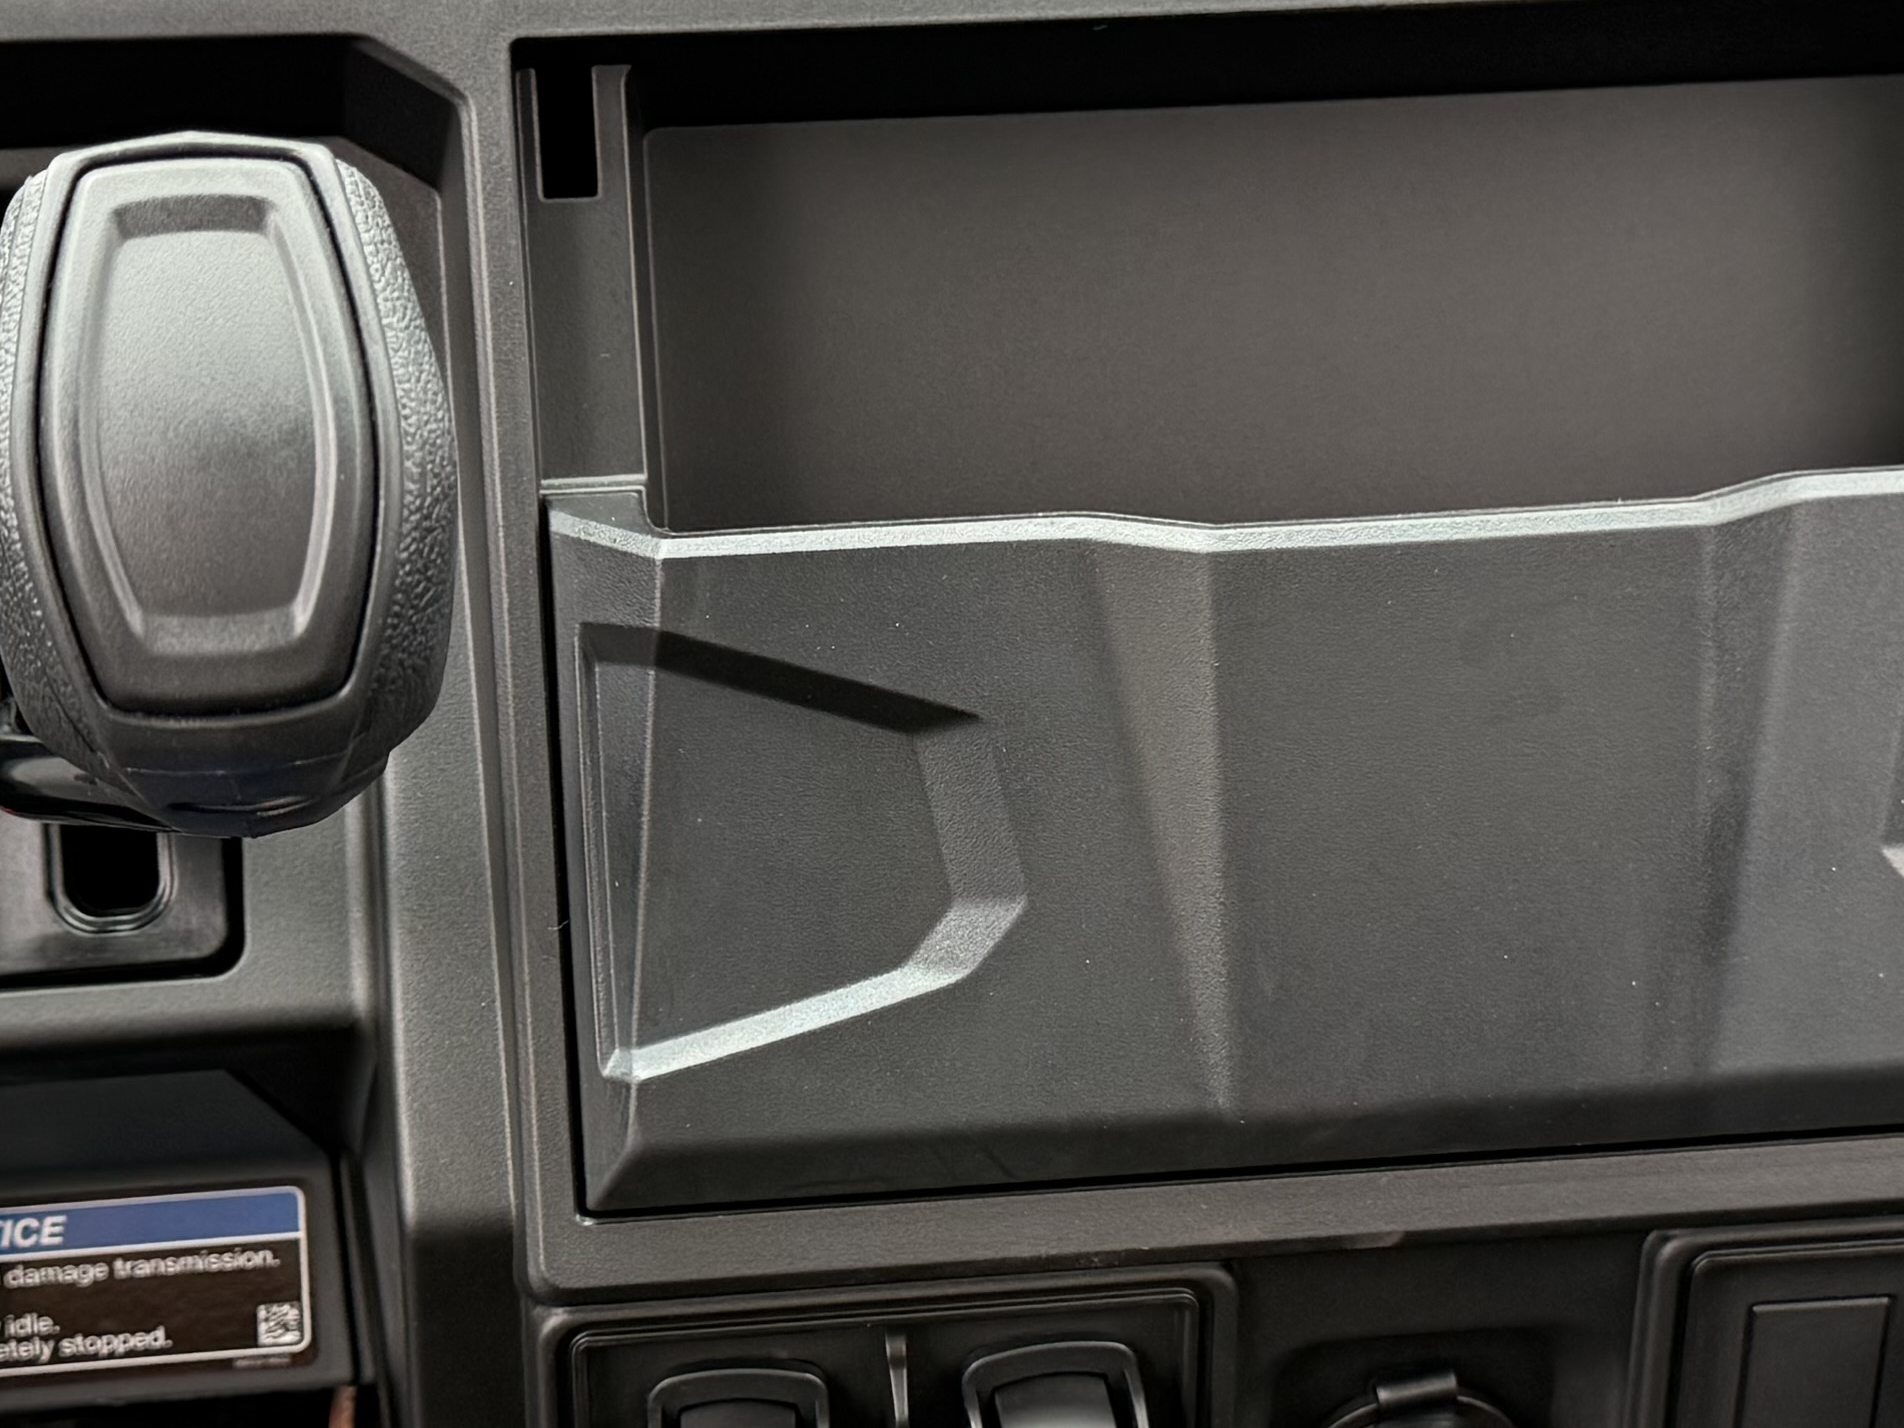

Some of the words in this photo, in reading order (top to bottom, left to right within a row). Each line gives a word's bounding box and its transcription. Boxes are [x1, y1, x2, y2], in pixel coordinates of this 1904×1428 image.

[4, 1259, 109, 1288] damage
[113, 1247, 281, 1280] transmission.
[4, 1312, 61, 1338] idle.
[59, 1325, 174, 1358] stopped.
